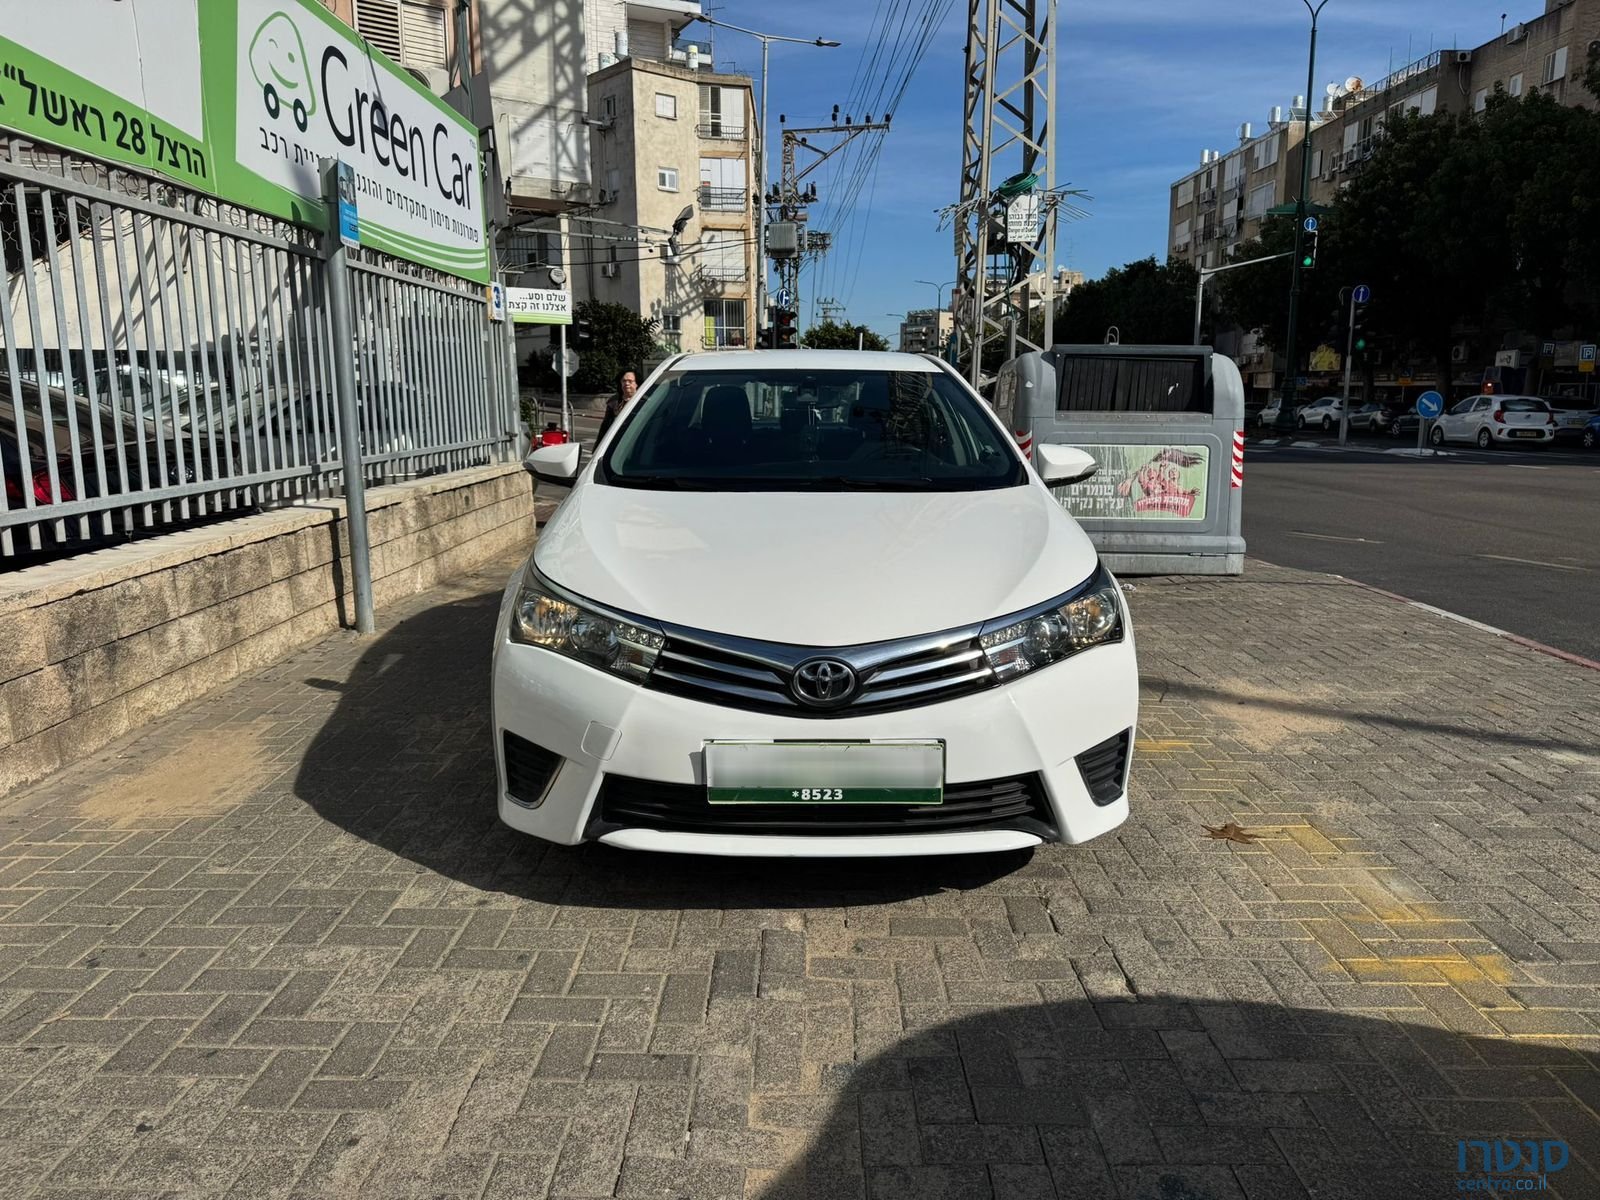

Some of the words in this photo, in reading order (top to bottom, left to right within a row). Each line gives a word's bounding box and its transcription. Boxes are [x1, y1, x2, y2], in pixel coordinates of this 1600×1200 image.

[0, 62, 107, 142] ראשל"
[113, 111, 146, 155] 28
[321, 45, 428, 187] Green
[433, 122, 473, 210] Car
[151, 123, 206, 178] הרצל
[259, 127, 288, 159] רכב
[357, 173, 383, 200] והוגנ
[386, 188, 427, 220] מתקדמים
[429, 208, 450, 230] מימון
[452, 219, 479, 242] פתרונות
[508, 301, 527, 311] קצת
[519, 292, 544, 301] וסע...
[530, 302, 540, 310] זה
[542, 302, 567, 312] אצלנו
[546, 293, 566, 301] שלם
[1071, 484, 1115, 496] שומרים
[1096, 497, 1125, 510] עליה
